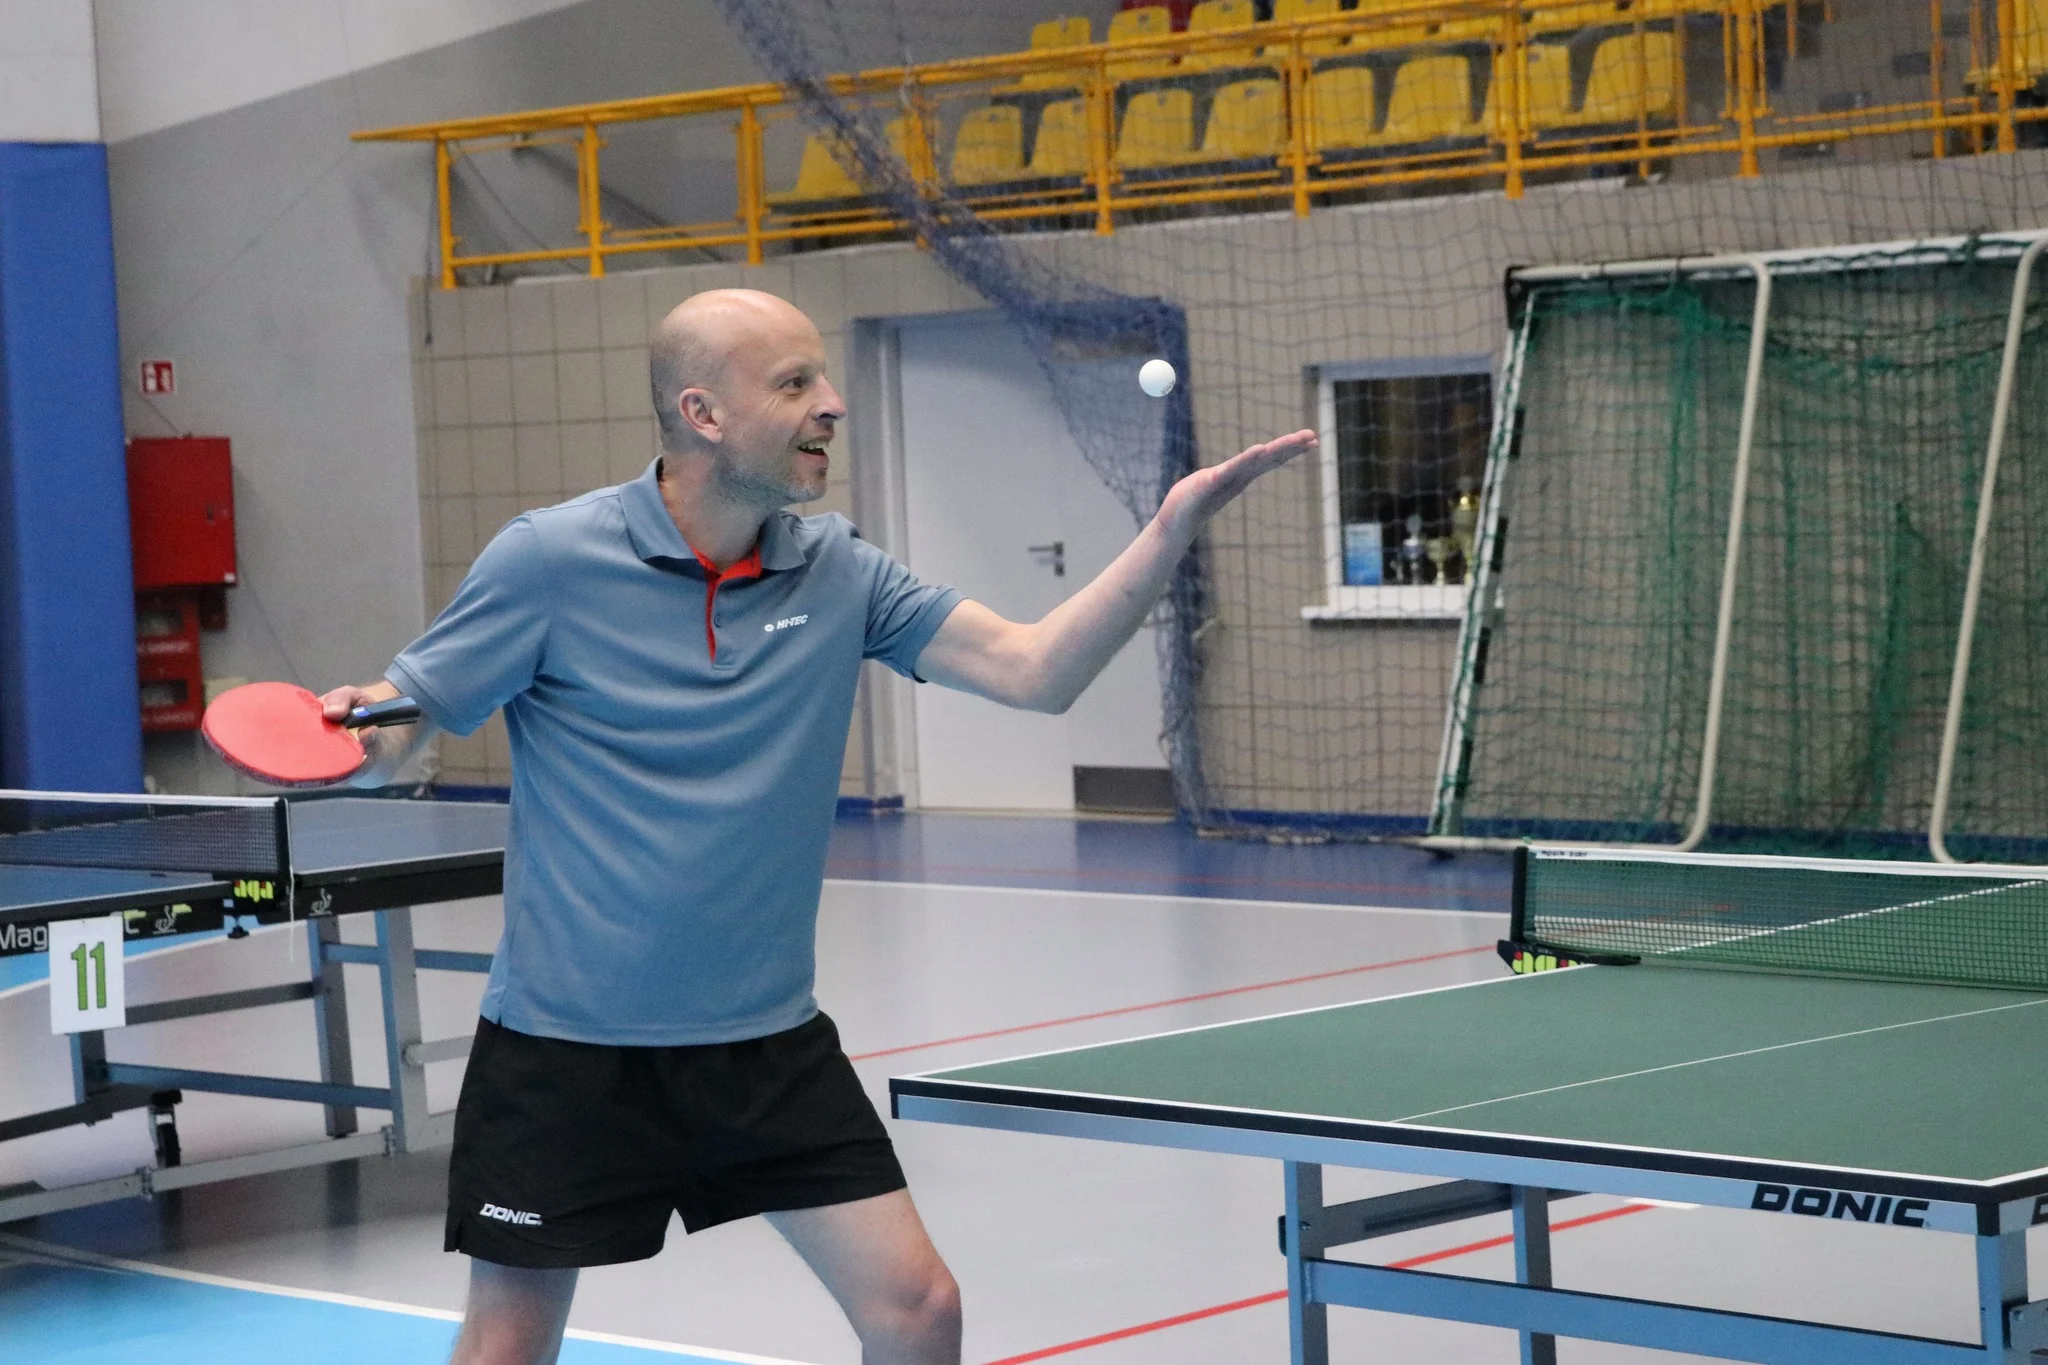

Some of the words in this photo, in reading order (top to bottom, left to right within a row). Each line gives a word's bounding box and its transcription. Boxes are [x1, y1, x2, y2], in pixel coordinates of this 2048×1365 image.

[776, 614, 809, 630] HI-TEC
[0, 923, 48, 951] Mag
[70, 941, 107, 1011] 11
[479, 1203, 542, 1225] DONIC
[1750, 1182, 1930, 1228] DONIC
